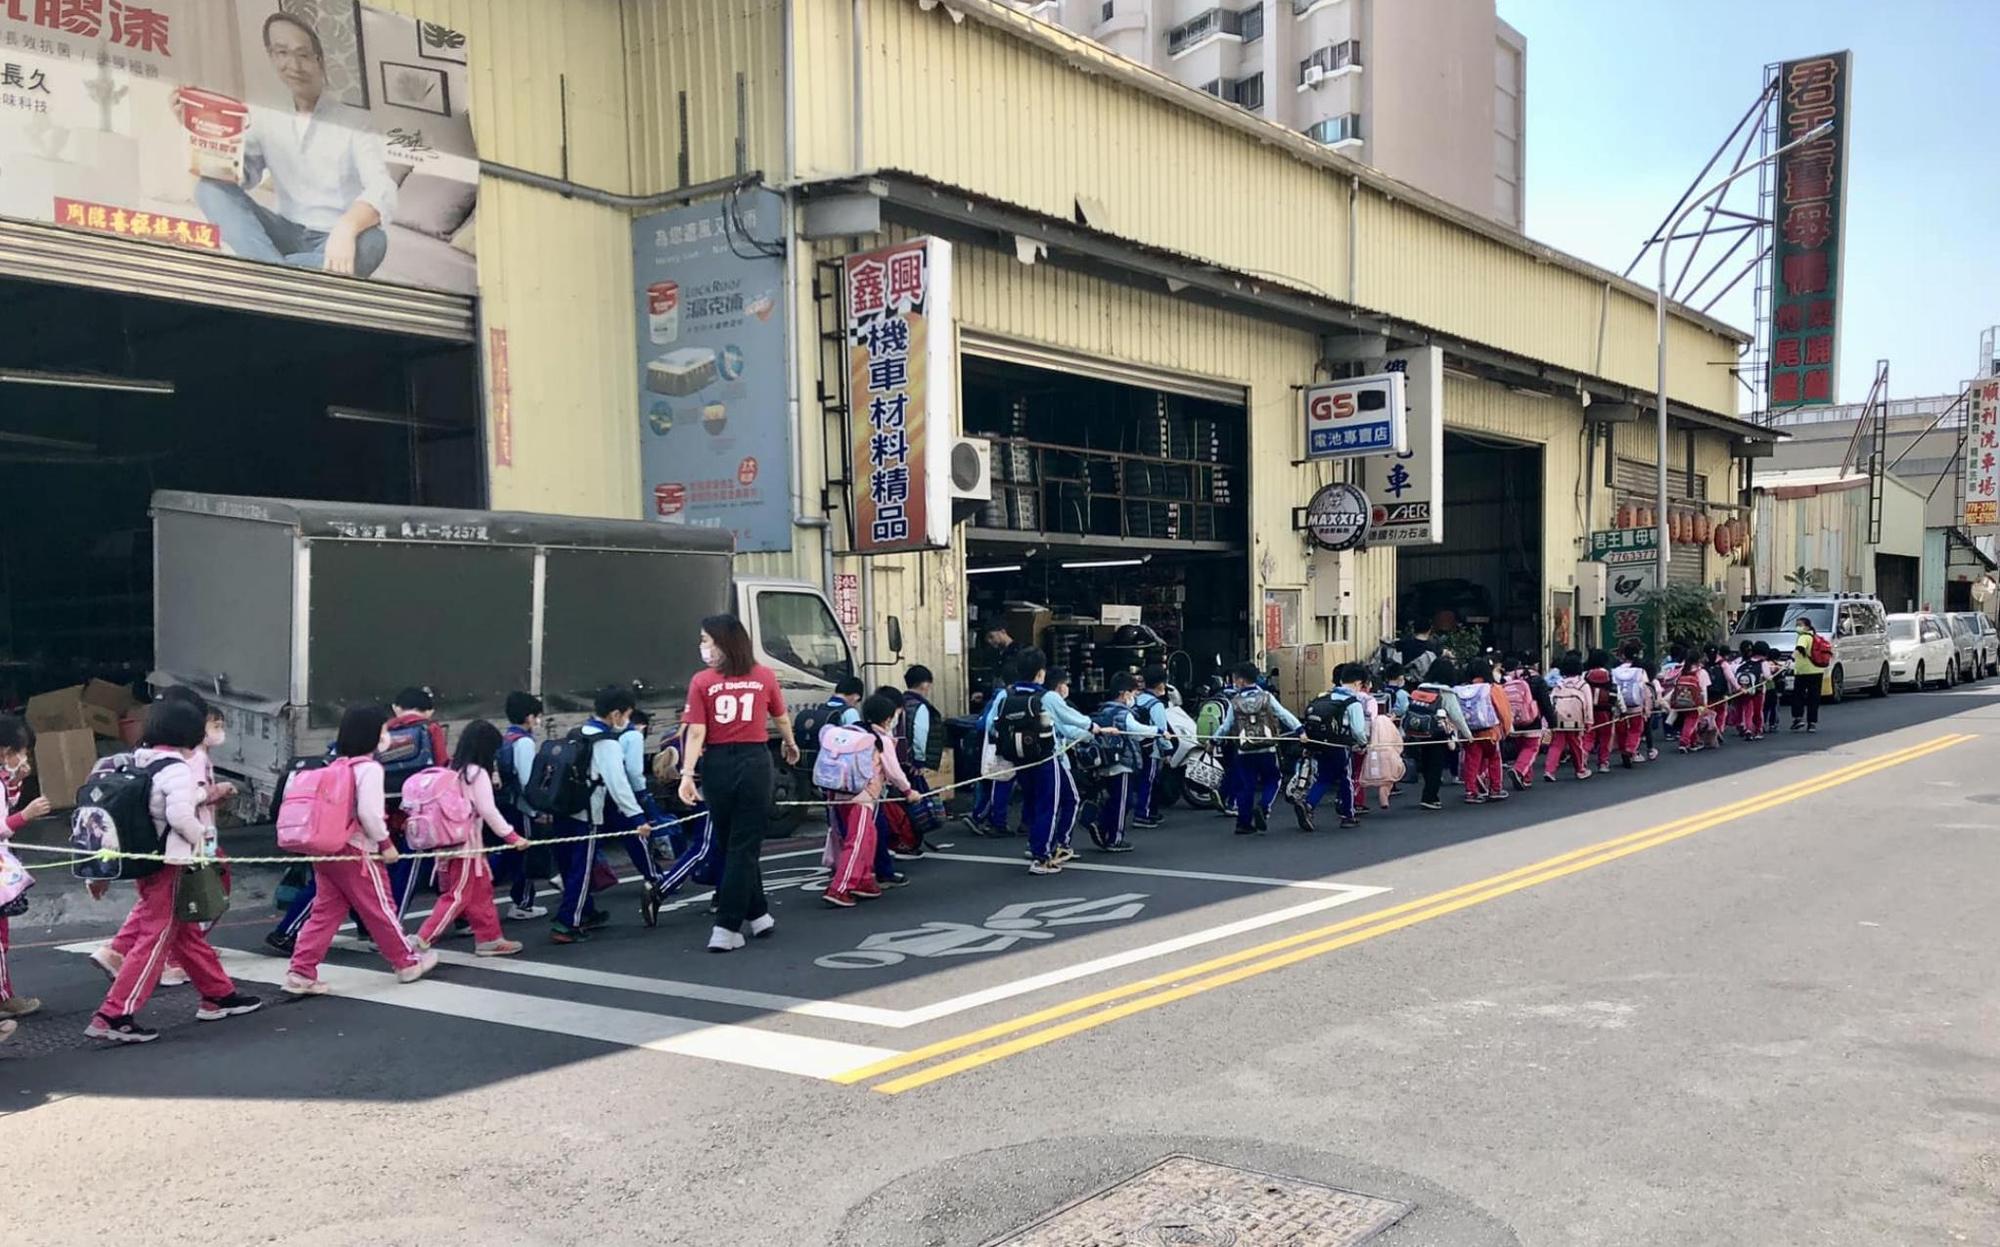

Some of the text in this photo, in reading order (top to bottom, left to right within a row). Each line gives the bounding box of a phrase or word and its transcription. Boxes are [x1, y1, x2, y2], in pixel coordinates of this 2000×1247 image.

[0, 0, 172, 57] 膠漆
[852, 251, 923, 316] 鑫興
[1311, 393, 1355, 421] GS
[868, 318, 909, 541] 機車材料精品
[1315, 427, 1388, 448] 電池專賣店
[1978, 381, 2000, 497] 順利洗車場
[1307, 513, 1366, 526] MAXXIS
[708, 681, 764, 696] JOY ENGLISH
[714, 693, 755, 724] 91
